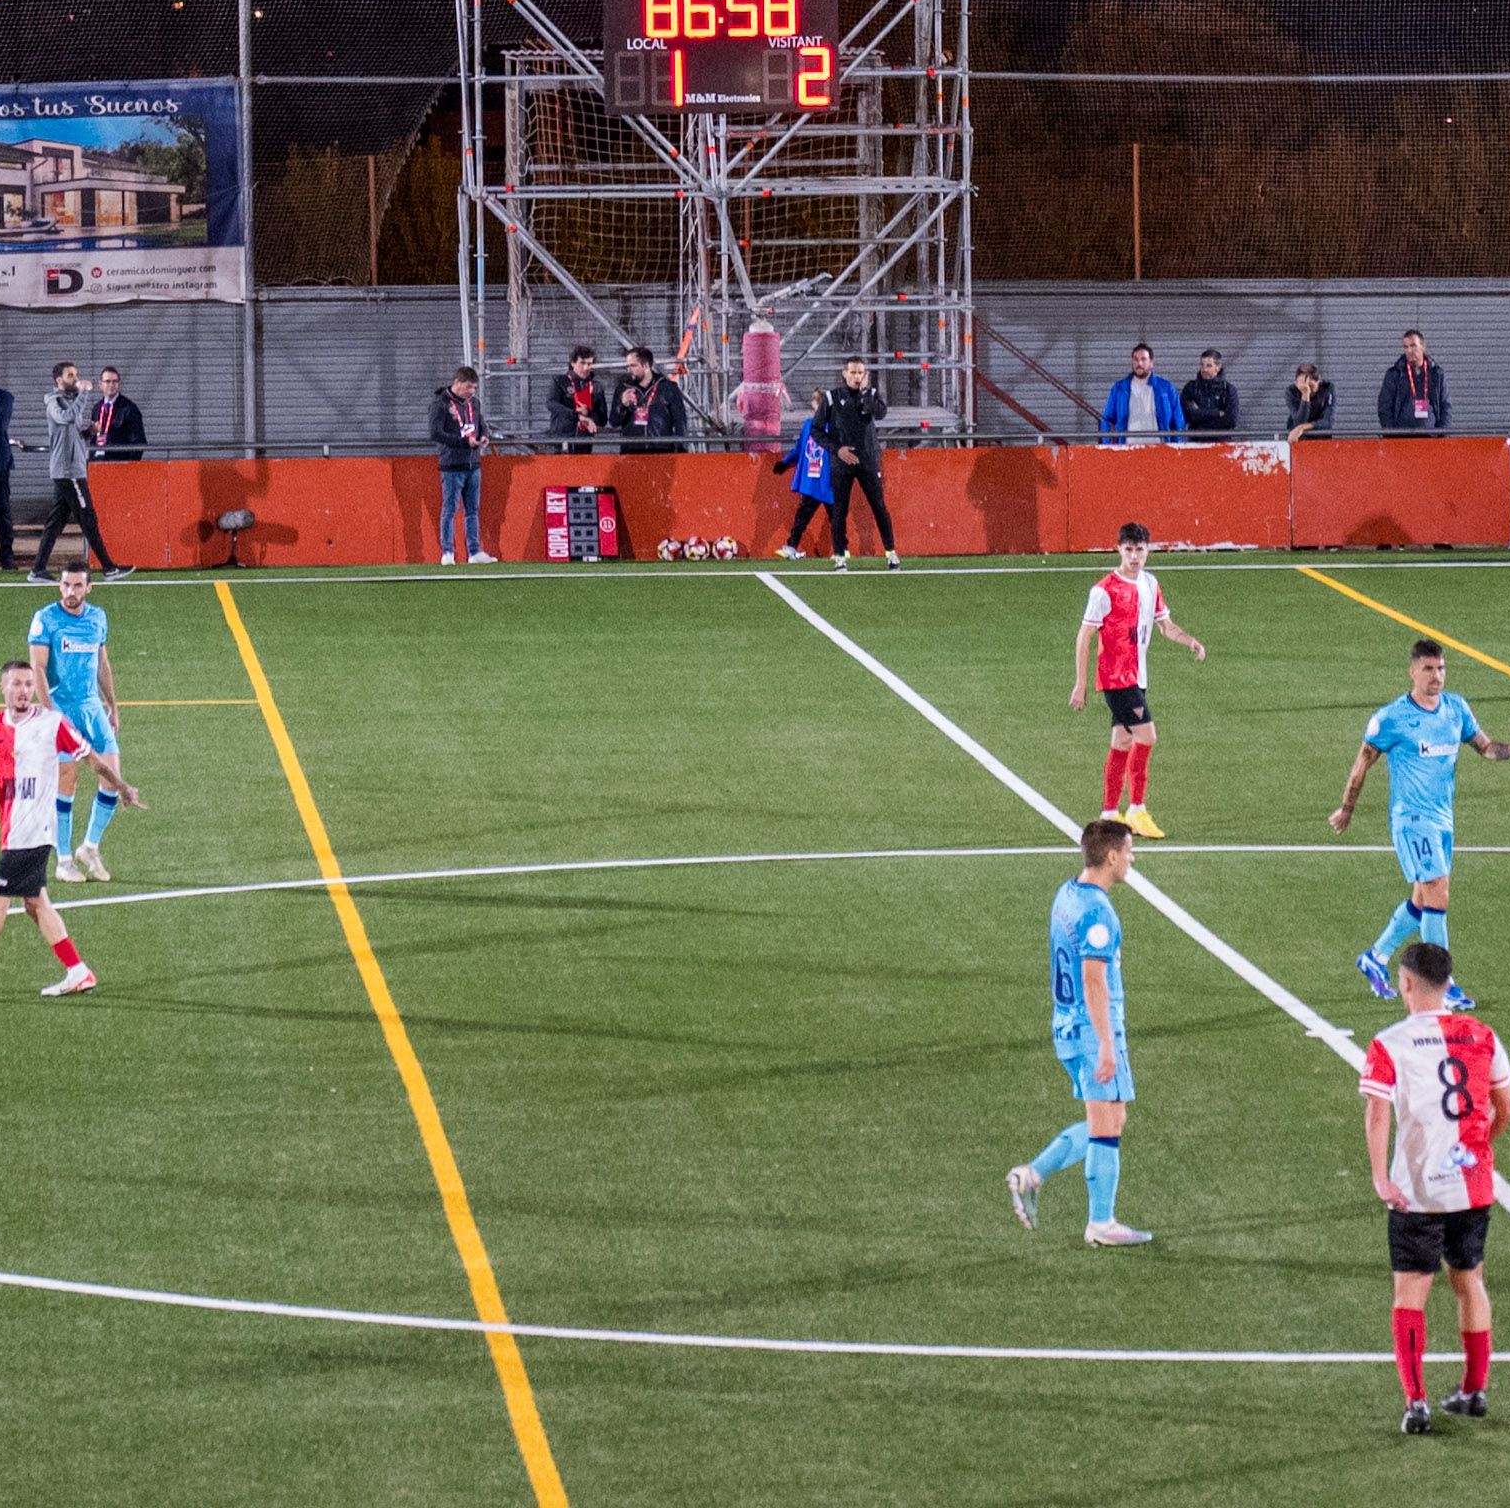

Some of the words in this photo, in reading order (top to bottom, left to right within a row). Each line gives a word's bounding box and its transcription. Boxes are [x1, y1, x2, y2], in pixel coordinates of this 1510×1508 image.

[626, 38, 668, 50] LOCAL
[768, 35, 823, 49] VISITANT
[798, 46, 833, 106] 2
[31, 96, 79, 116] tus
[685, 93, 717, 103] M&M
[717, 93, 761, 103] Electronics
[106, 282, 132, 292] Sigue
[172, 279, 217, 291] instagram
[546, 492, 566, 513] REY
[548, 527, 568, 557] COPA
[1412, 836, 1433, 861] 14
[1054, 945, 1076, 1006] 6
[1437, 1056, 1474, 1122] 8
